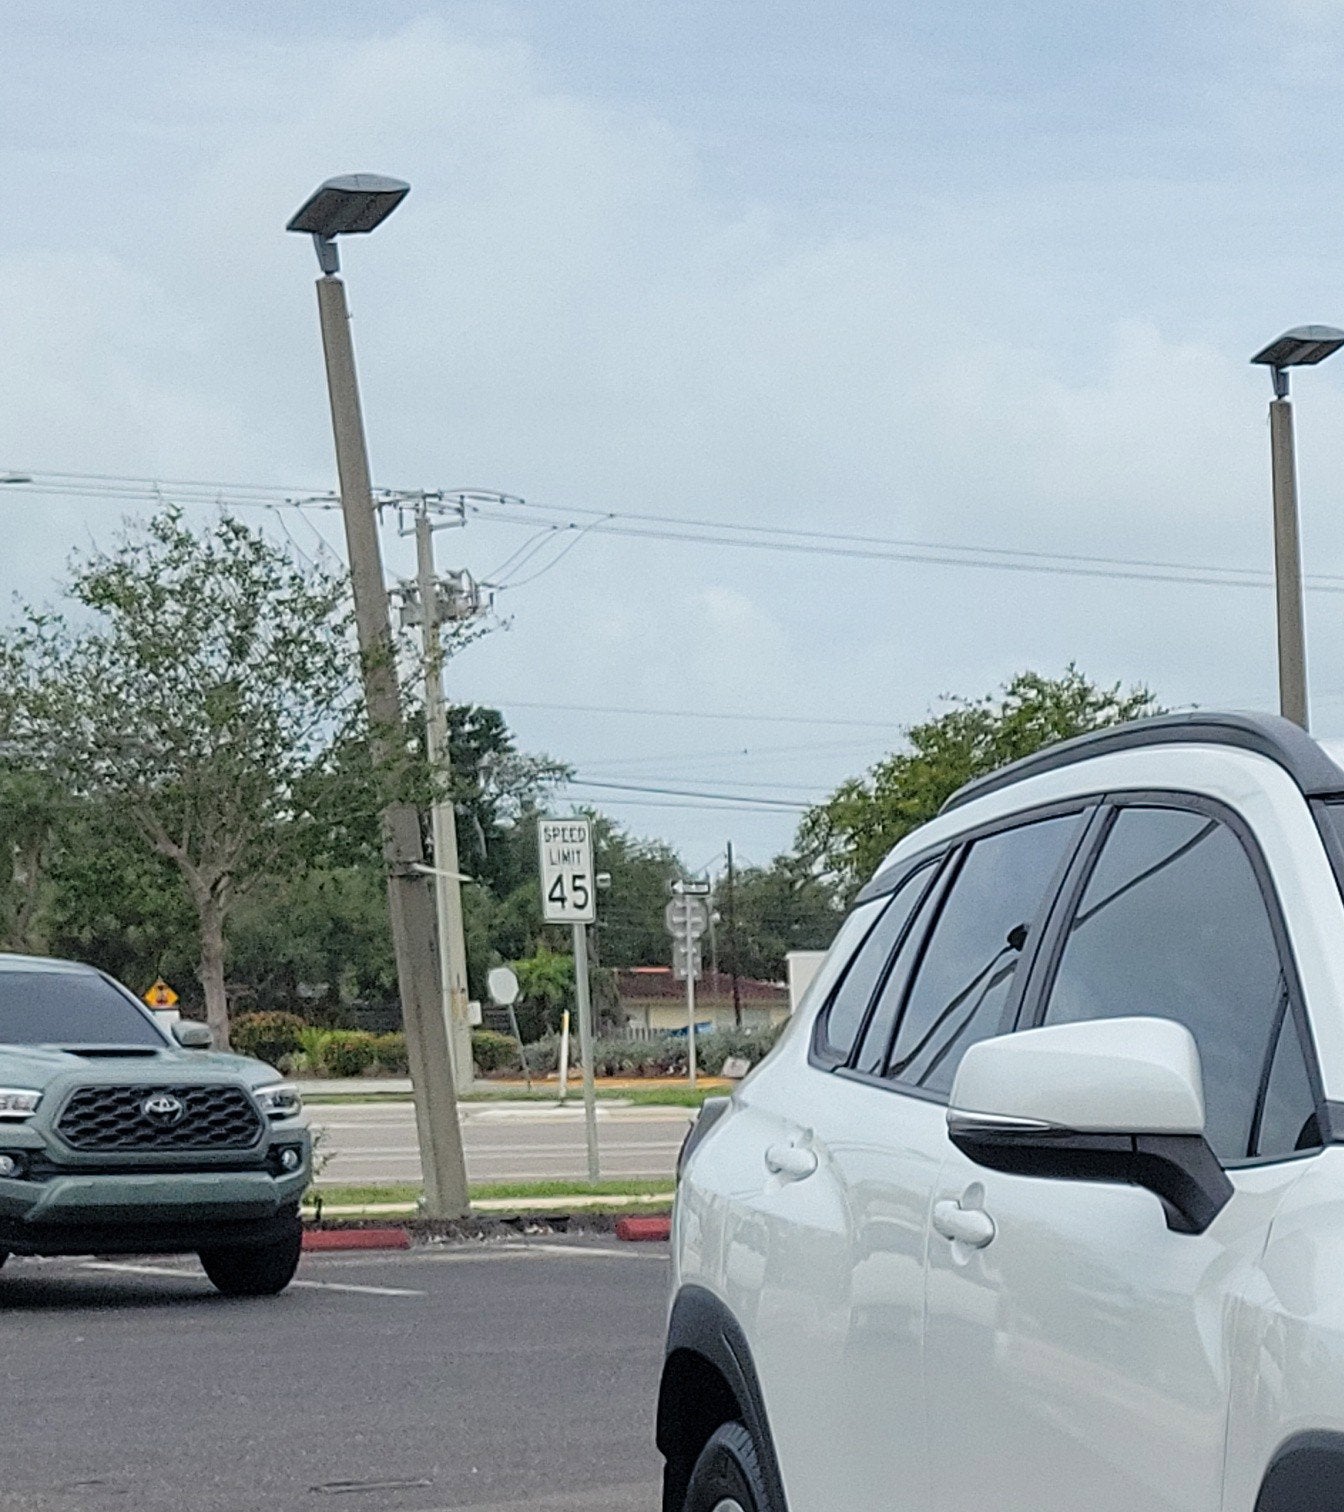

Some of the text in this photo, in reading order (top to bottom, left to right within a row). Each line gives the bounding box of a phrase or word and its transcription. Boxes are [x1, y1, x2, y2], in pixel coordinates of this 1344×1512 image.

[543, 826, 586, 843] SPEED
[549, 849, 582, 866] LIMIT
[548, 874, 589, 910] 45
